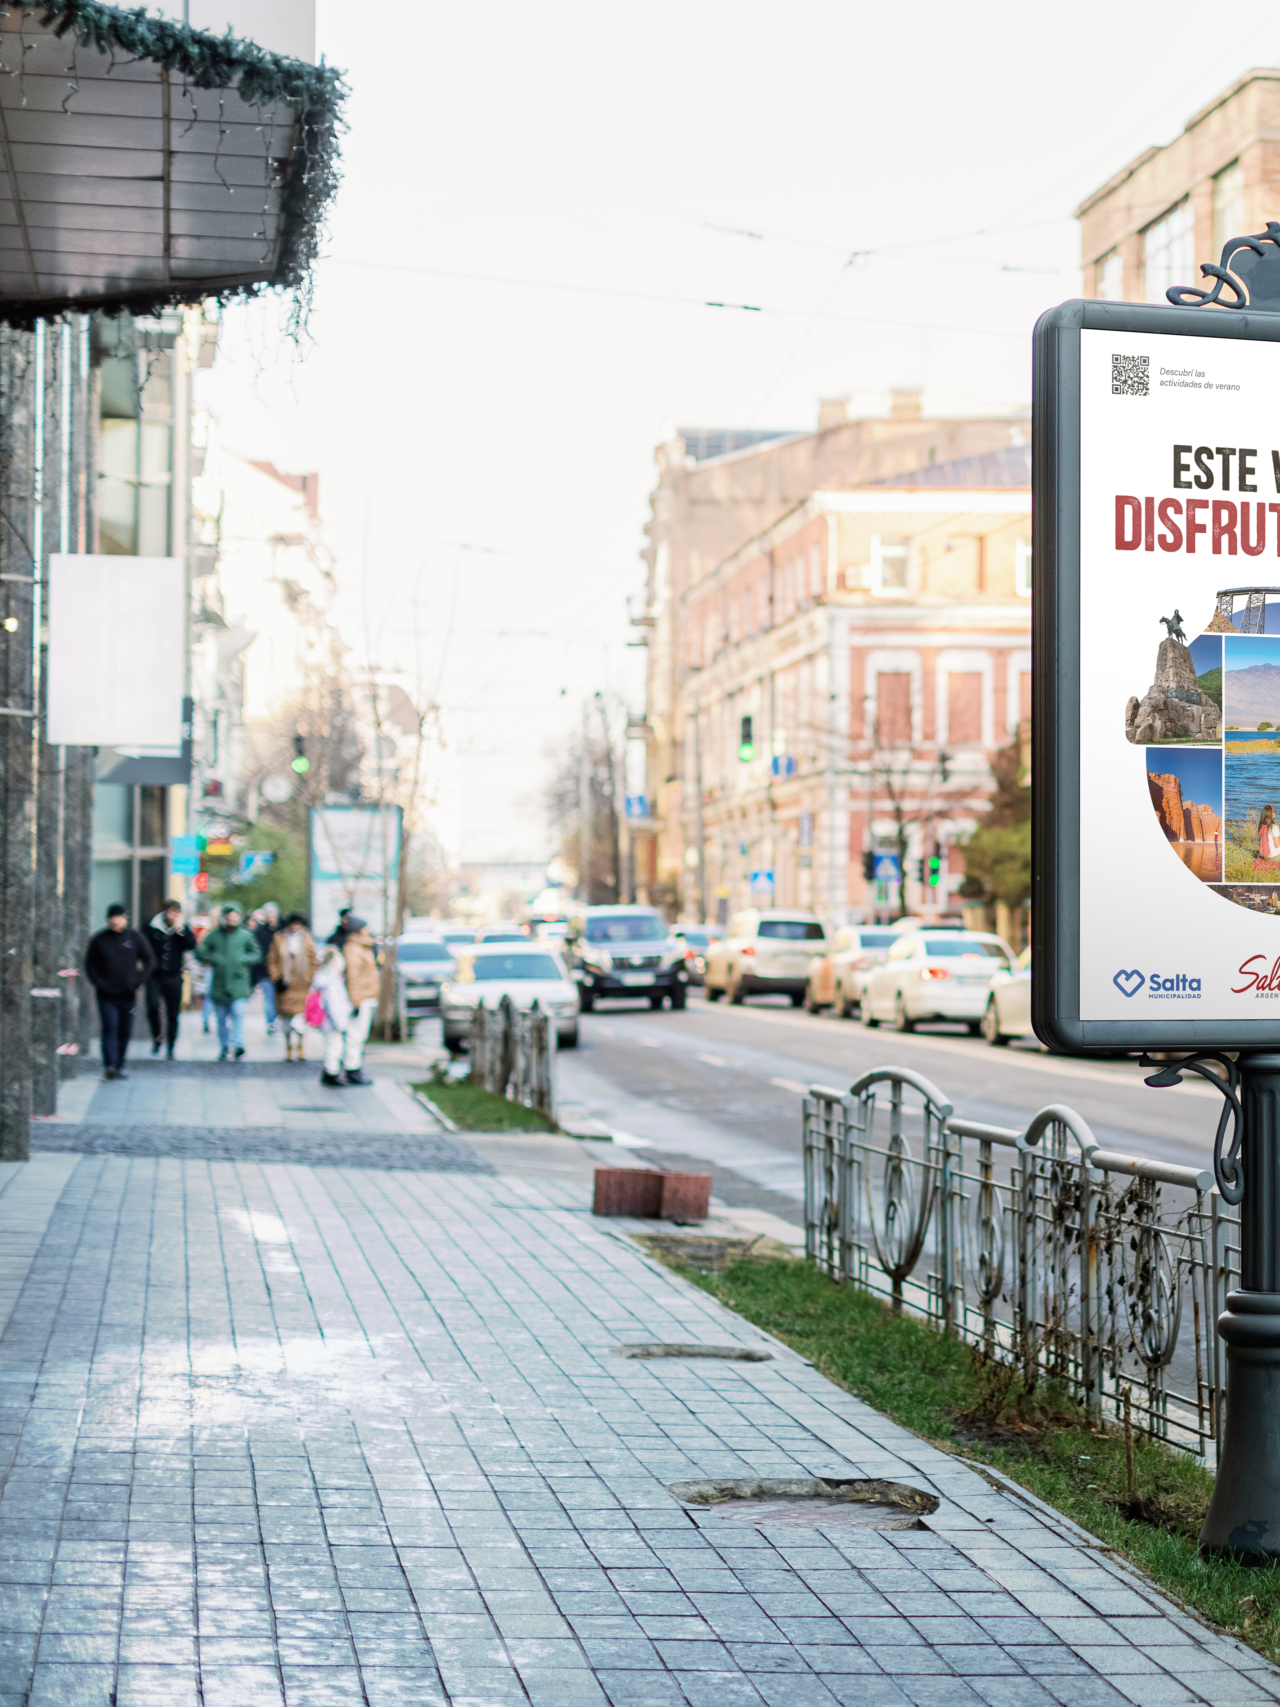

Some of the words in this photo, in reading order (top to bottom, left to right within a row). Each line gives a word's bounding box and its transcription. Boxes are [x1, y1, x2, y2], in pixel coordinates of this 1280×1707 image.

[1159, 367, 1194, 378] Descubrí
[1194, 369, 1206, 378] las
[1159, 379, 1202, 389] actividades
[1203, 381, 1213, 389] de
[1215, 383, 1241, 391] verano
[1173, 444, 1258, 493] ESTE
[1148, 973, 1202, 992] Salta
